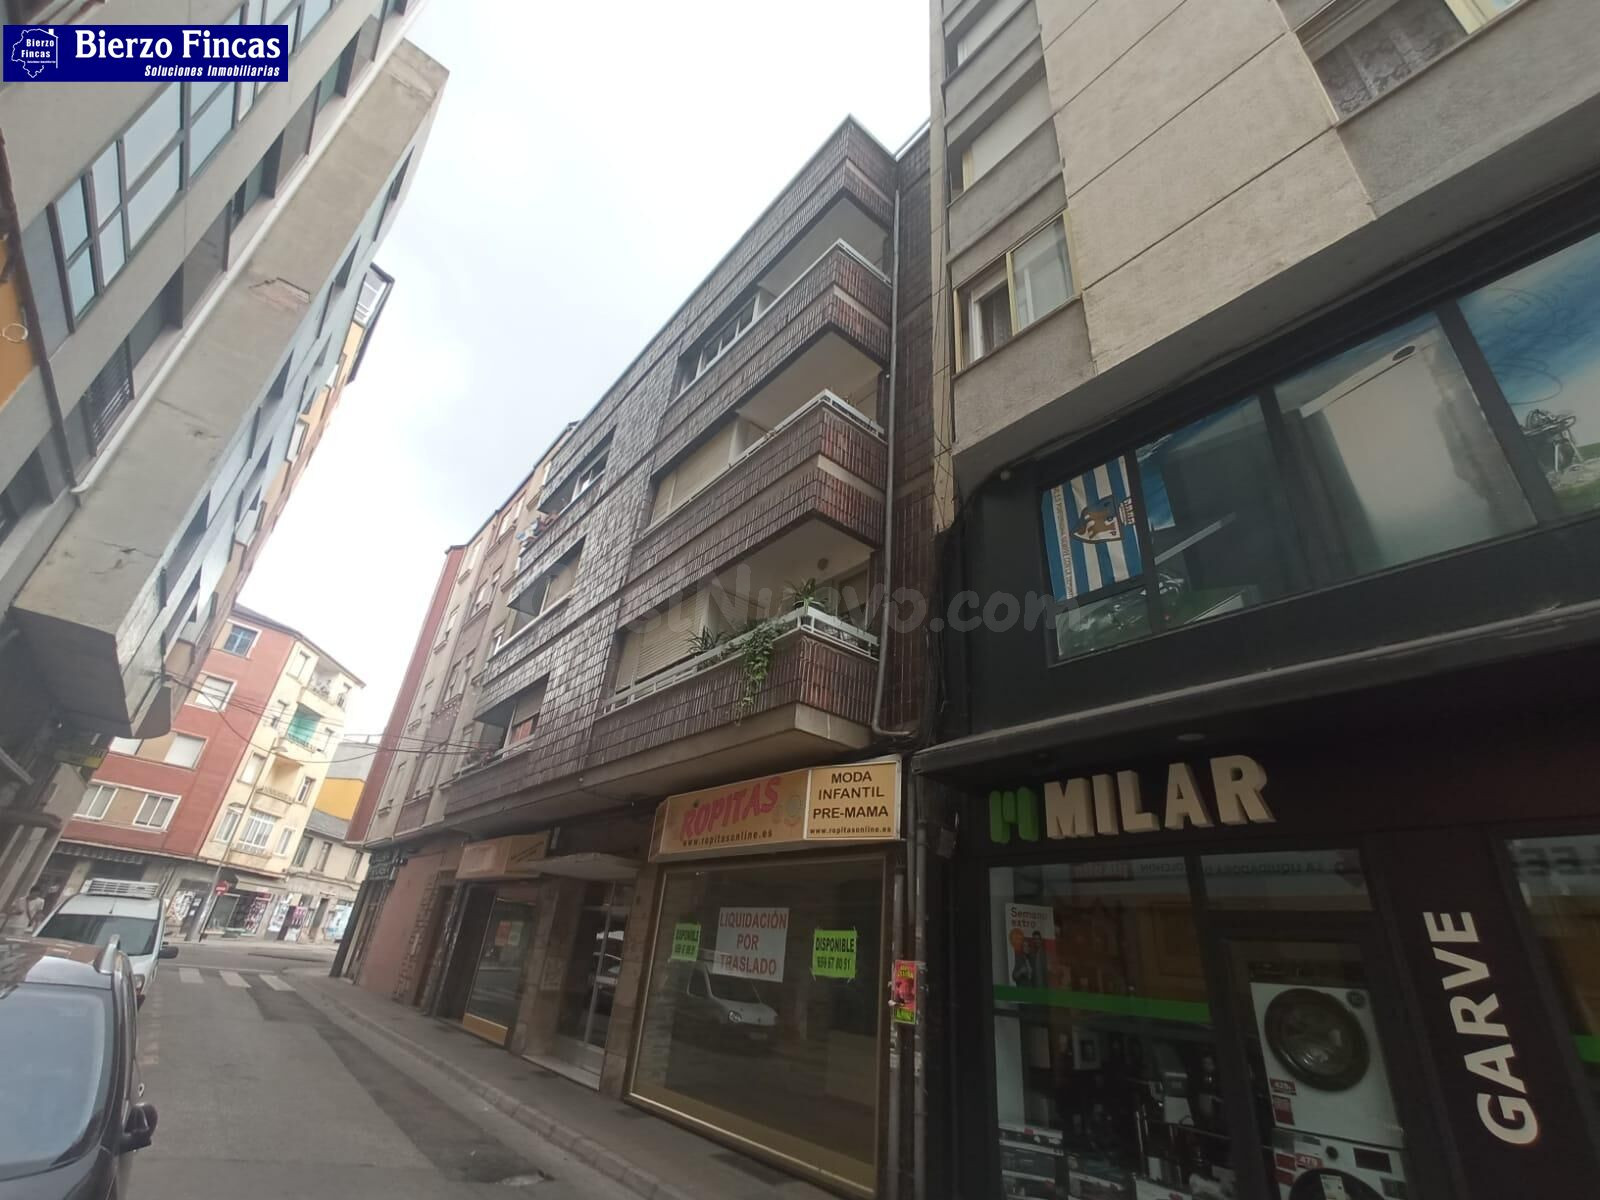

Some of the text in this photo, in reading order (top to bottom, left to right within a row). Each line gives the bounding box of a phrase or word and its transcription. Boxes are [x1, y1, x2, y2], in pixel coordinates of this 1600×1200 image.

[831, 770, 872, 784] MODA
[818, 786, 885, 801] INFANTIL
[1043, 754, 1276, 840] MILAR
[679, 776, 782, 840] ROPITAS
[813, 805, 889, 820] PRE-MAMA
[682, 829, 774, 848] www.ropitasonline.es
[810, 825, 892, 835] www.ropitasonline.es
[719, 910, 787, 930] LIQUIDACIÓN
[736, 934, 760, 950] POR
[815, 936, 855, 953] DISPONIBLE
[720, 954, 777, 976] TRASLADO
[1423, 911, 1539, 1145] GARVE
